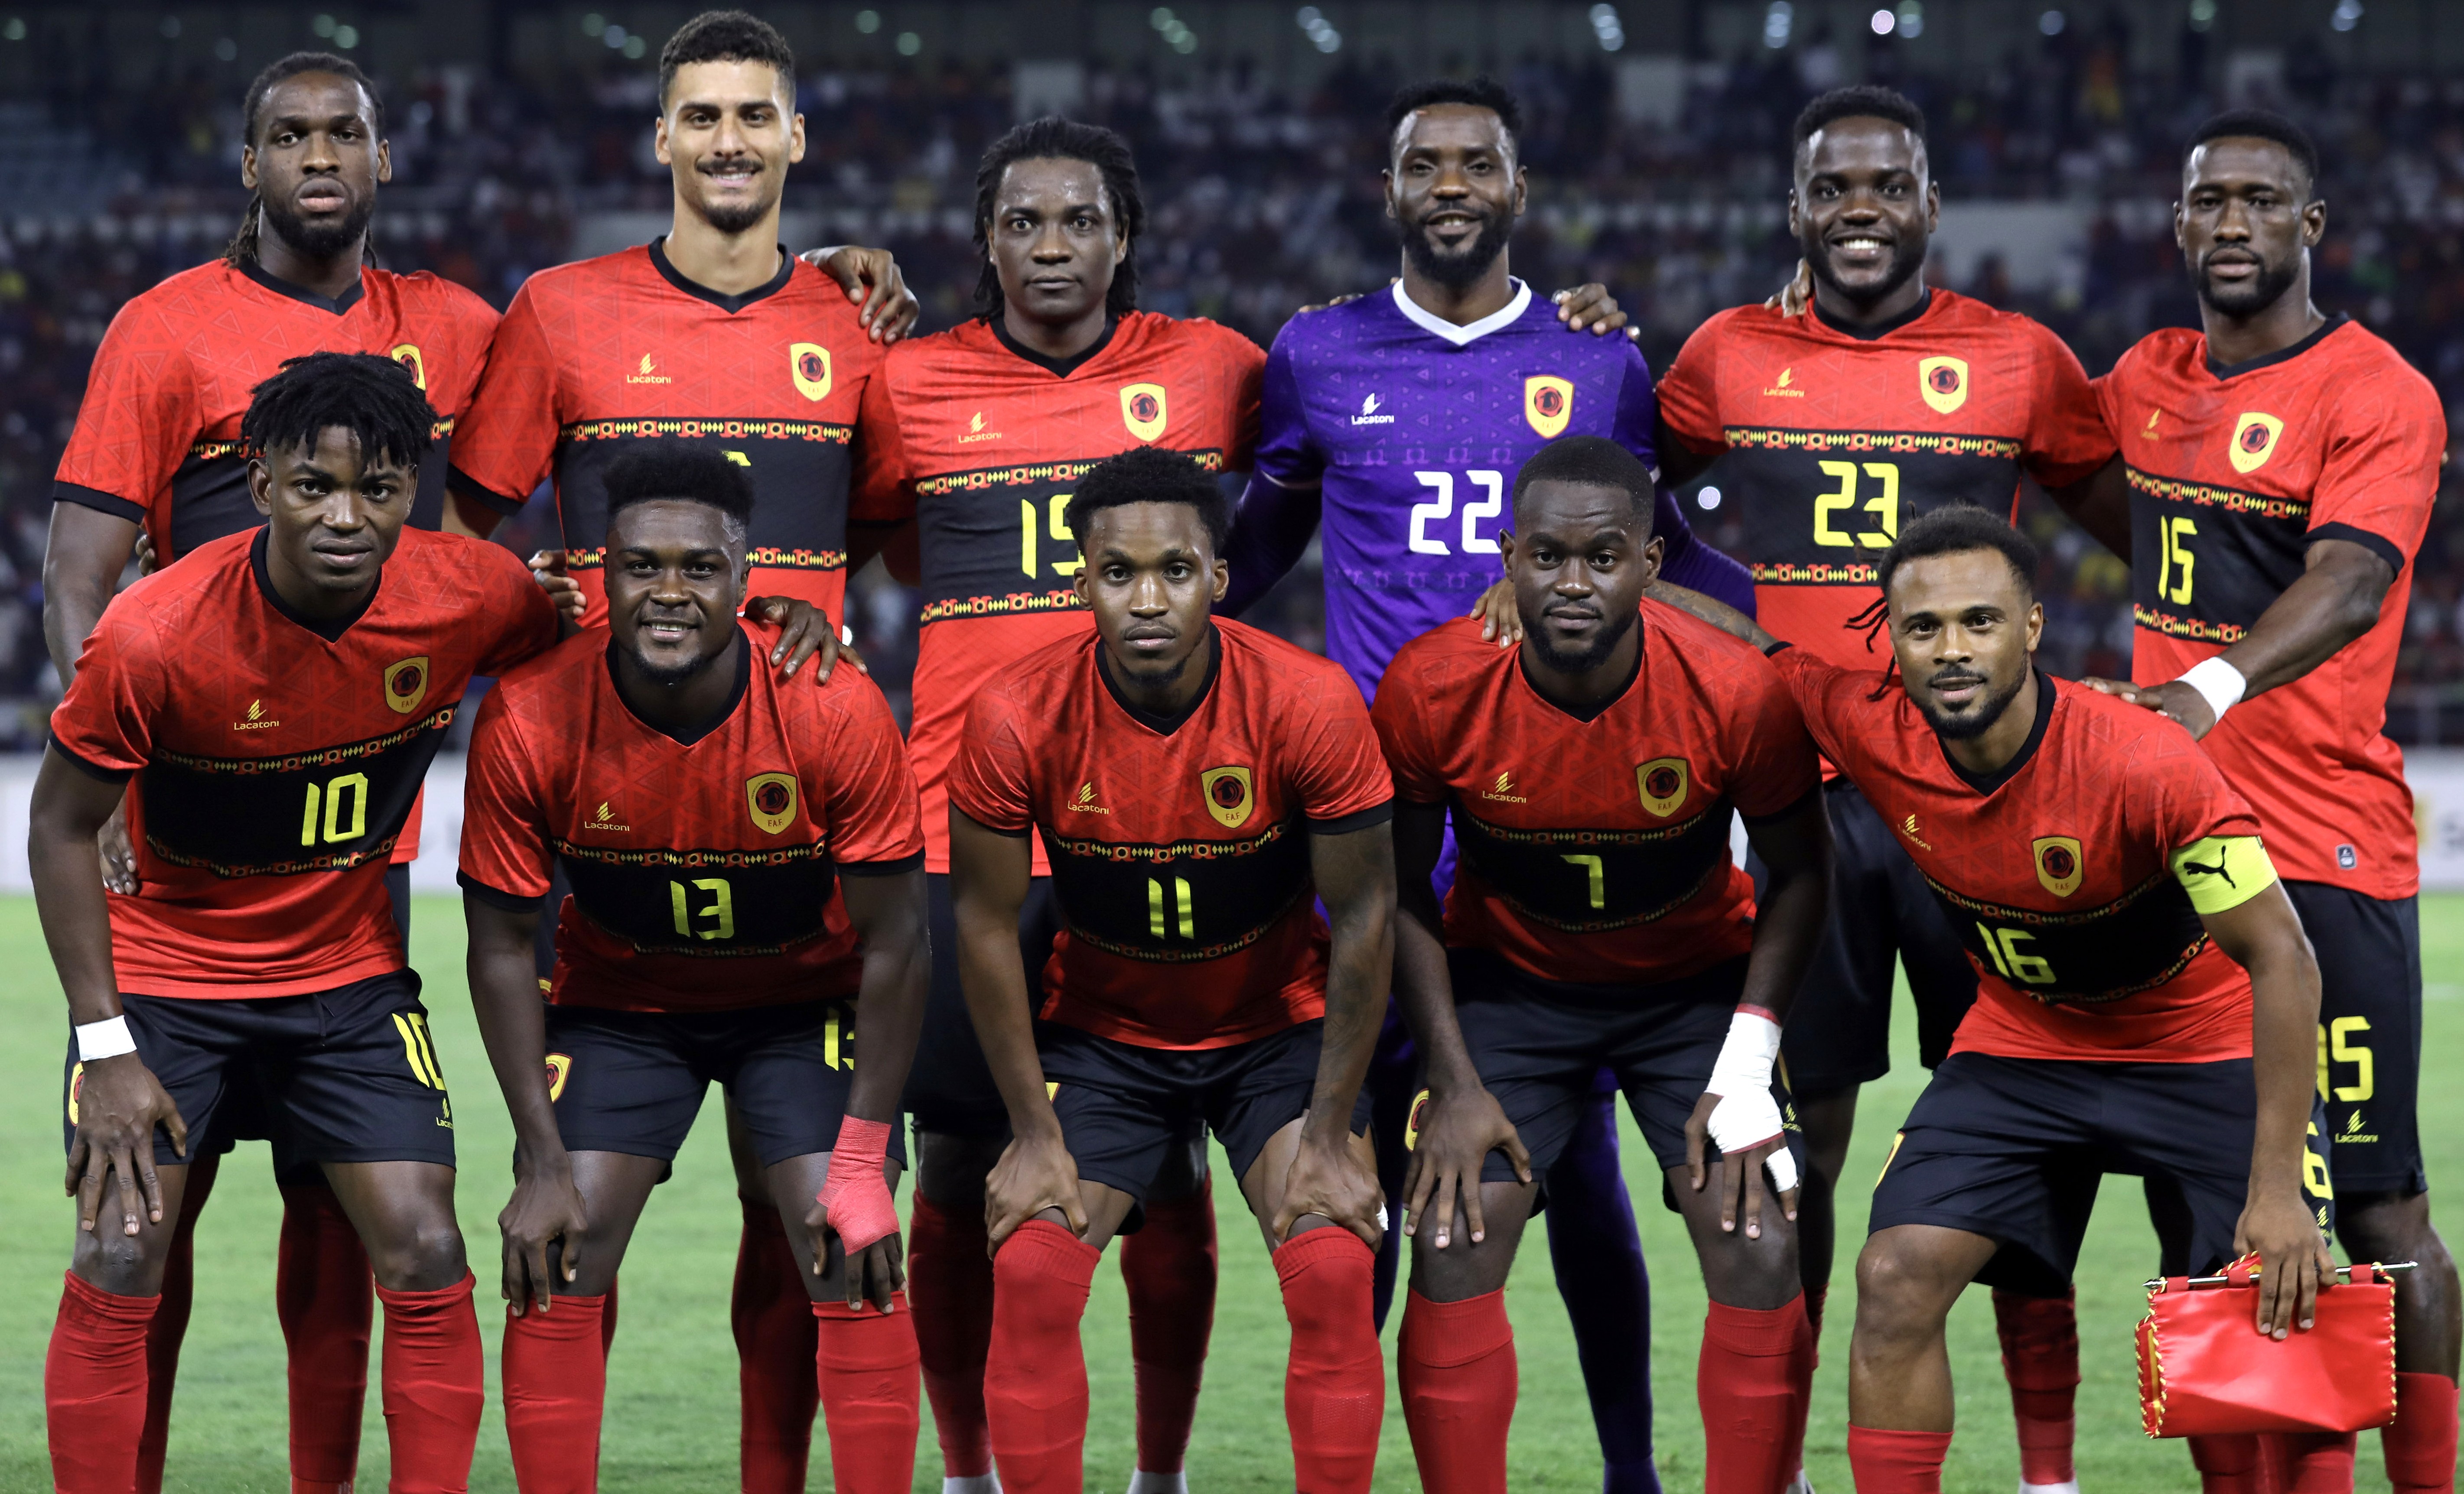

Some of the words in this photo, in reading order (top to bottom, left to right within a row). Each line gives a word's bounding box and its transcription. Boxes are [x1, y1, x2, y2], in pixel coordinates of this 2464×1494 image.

[627, 374, 671, 384] Lacatoni
[958, 432, 1002, 444] Lacatoni
[1351, 415, 1394, 425] Lacatoni
[1409, 470, 1503, 555] 22
[1813, 460, 1899, 549] 23
[2158, 514, 2198, 605] 15
[234, 721, 279, 730] Lacatoni
[302, 772, 368, 848] 10
[584, 821, 630, 831] Lacatoni
[1068, 800, 1110, 815] Lacatoni
[1482, 790, 1527, 803] Lacatoni
[670, 878, 734, 940] 13
[1148, 876, 1194, 940] 11
[1560, 854, 1605, 909] 7
[1976, 921, 2057, 984] 16
[825, 1007, 854, 1071] 1
[2317, 1016, 2373, 1103] 15
[2303, 1121, 2334, 1200] 6
